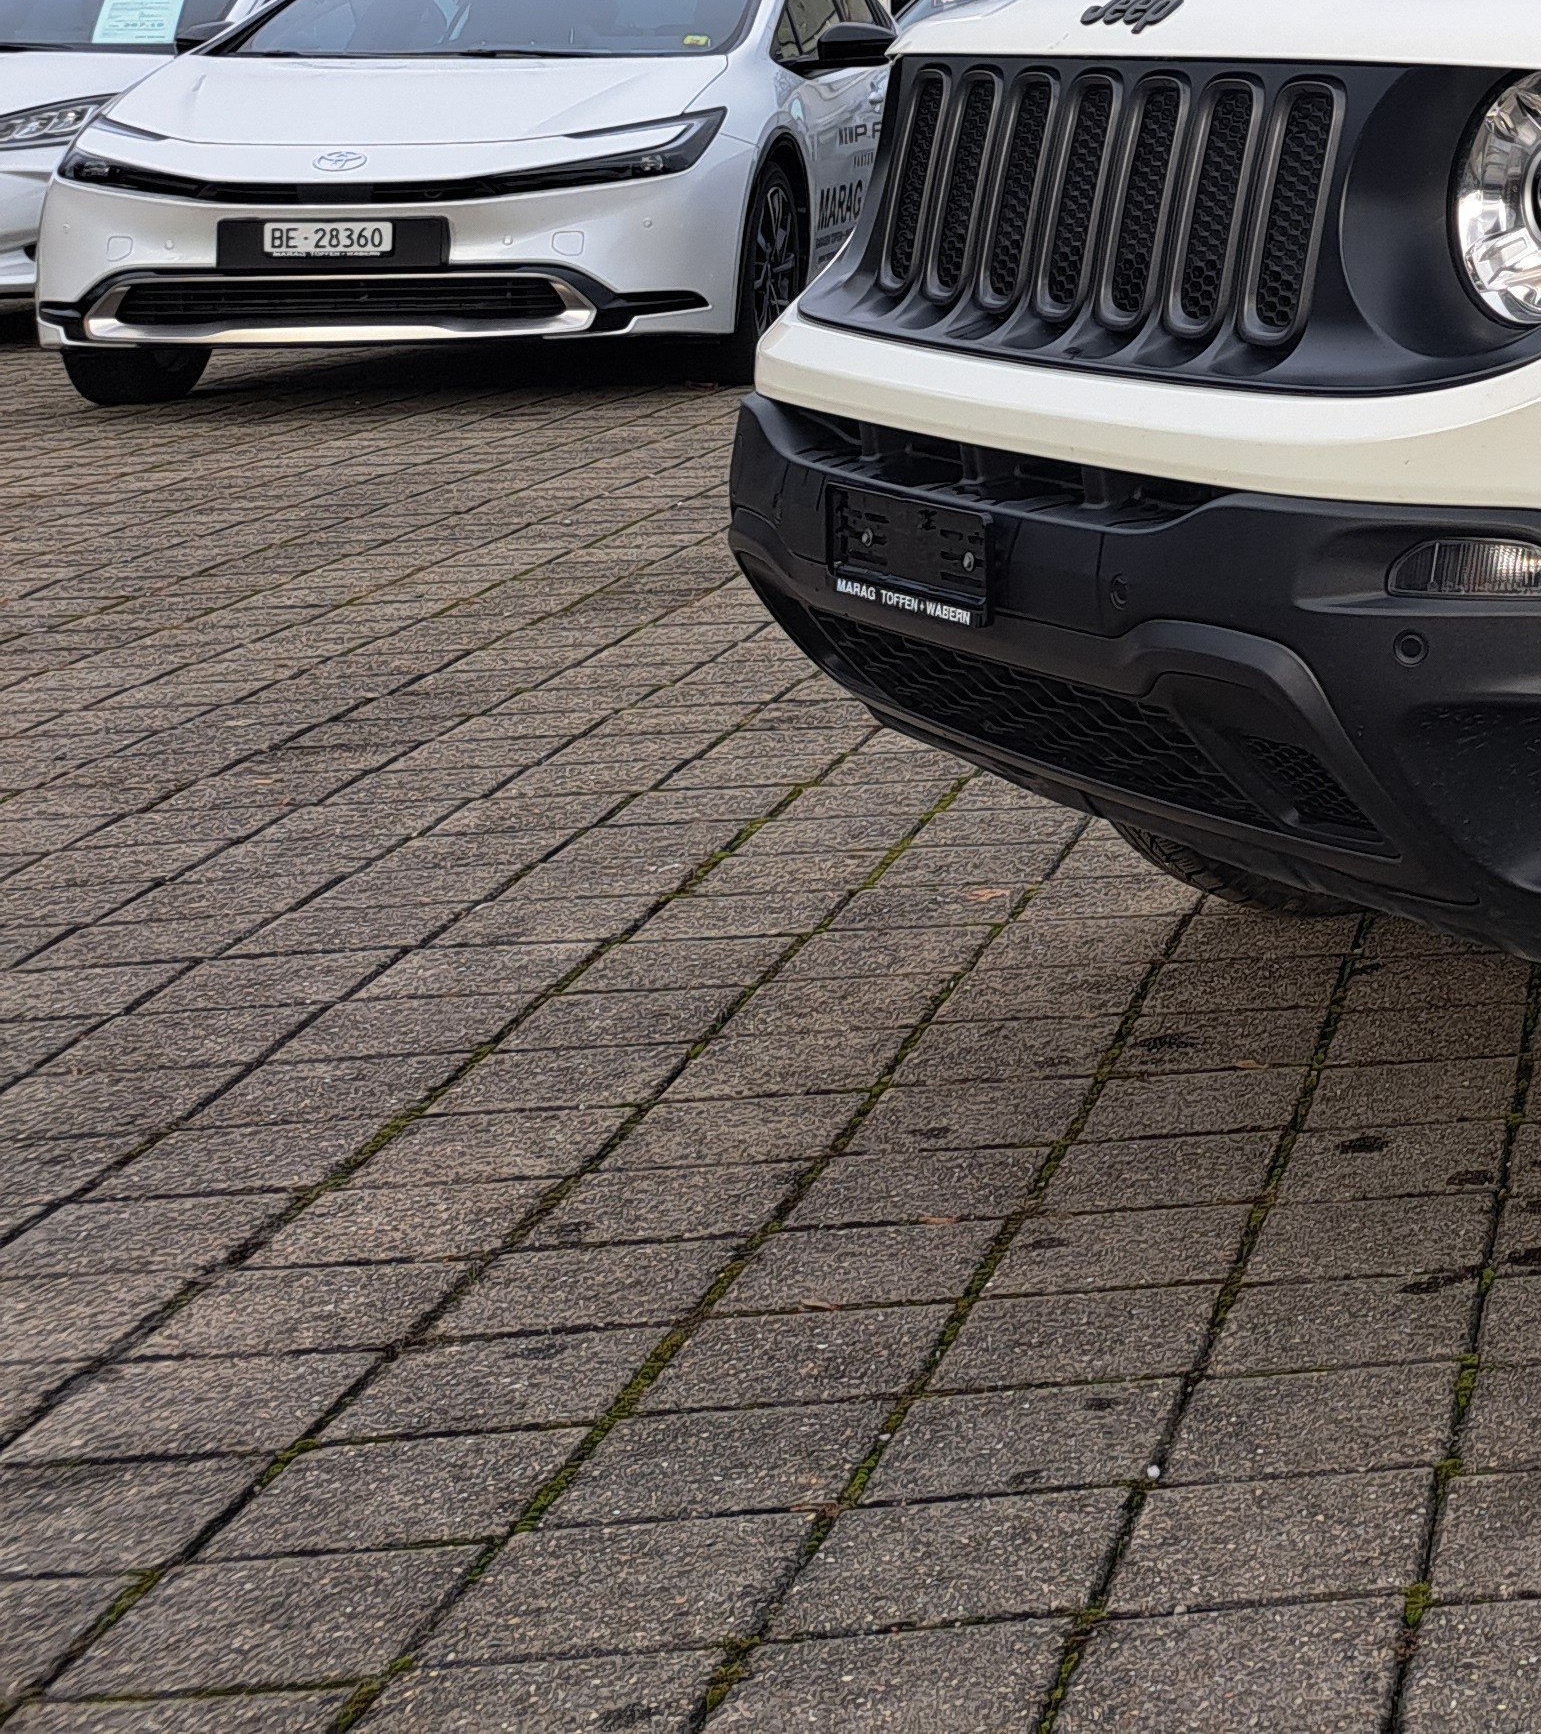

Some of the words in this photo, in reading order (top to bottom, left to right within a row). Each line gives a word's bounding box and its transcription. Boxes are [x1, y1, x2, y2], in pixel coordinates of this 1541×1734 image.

[818, 179, 863, 231] MARAG
[836, 578, 876, 600] MARAG
[880, 589, 919, 613] TOFFEN
[926, 601, 971, 626] WABERN
